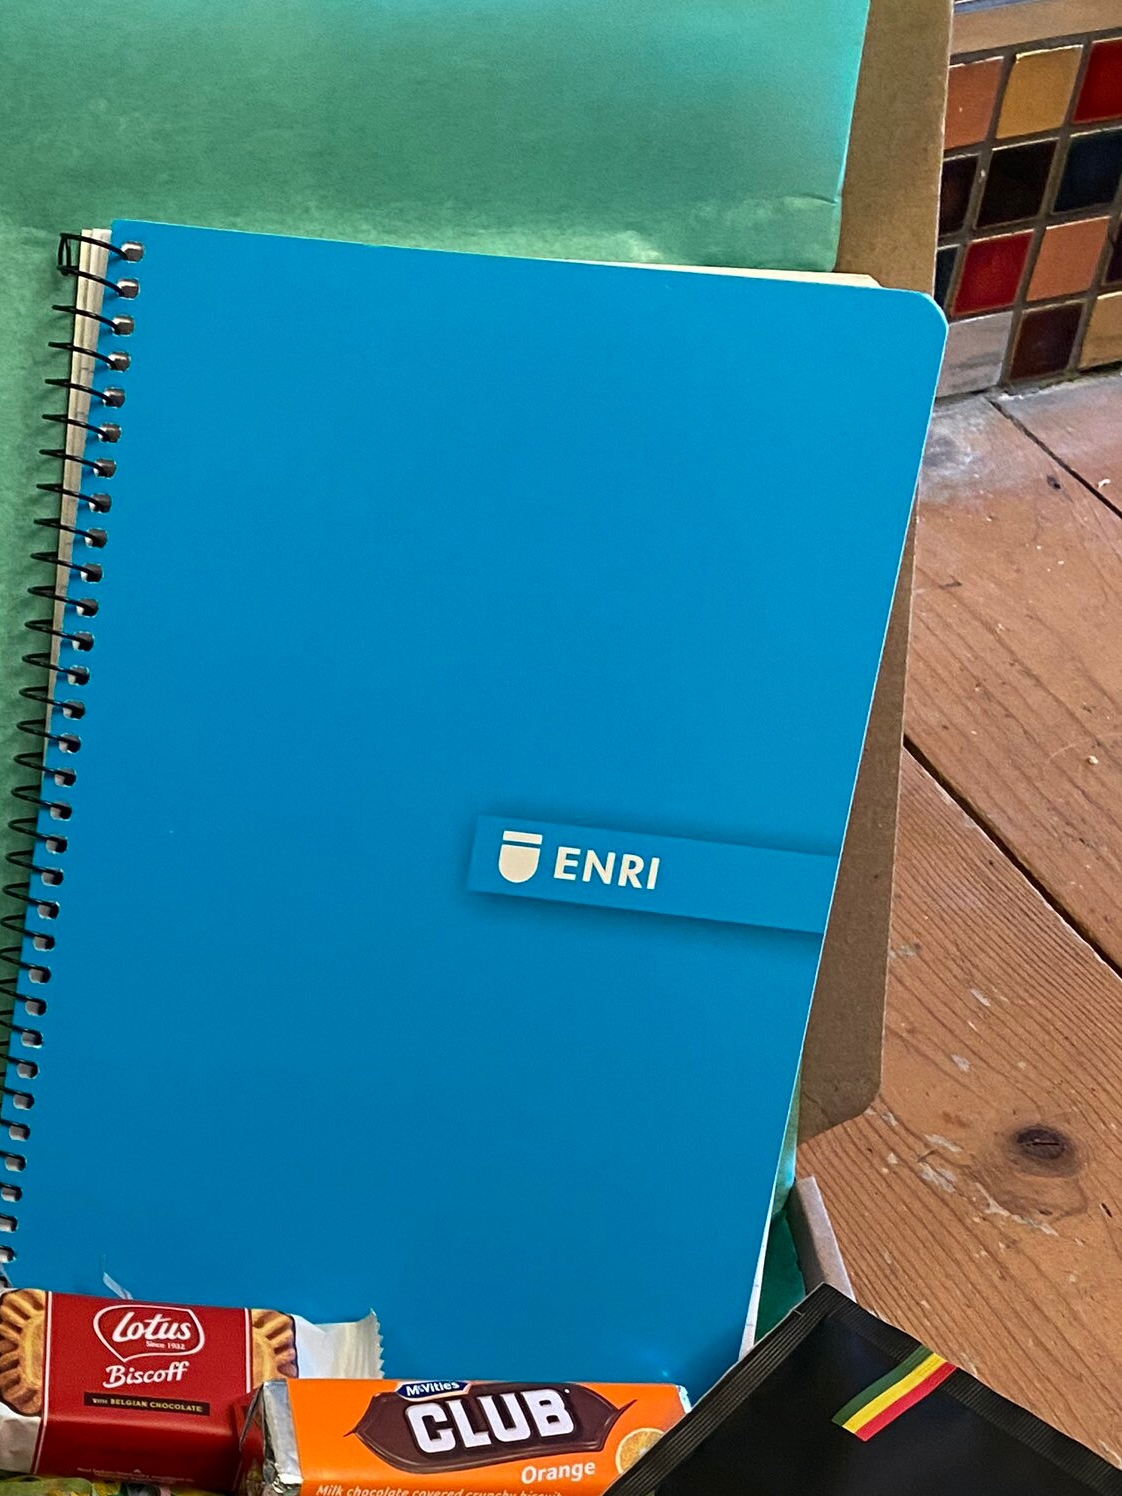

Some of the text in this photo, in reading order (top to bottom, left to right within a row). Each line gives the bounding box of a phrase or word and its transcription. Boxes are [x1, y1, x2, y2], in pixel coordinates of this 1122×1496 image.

[553, 846, 661, 890] ENRI
[111, 1311, 192, 1343] Lotus
[145, 1340, 187, 1351] Since 1932
[102, 1360, 190, 1389] Biscoff
[110, 1398, 148, 1408] BELGIAN
[149, 1401, 204, 1413] CHOCOLATE
[404, 1389, 576, 1455] CLUB
[520, 1461, 596, 1485] Orange
